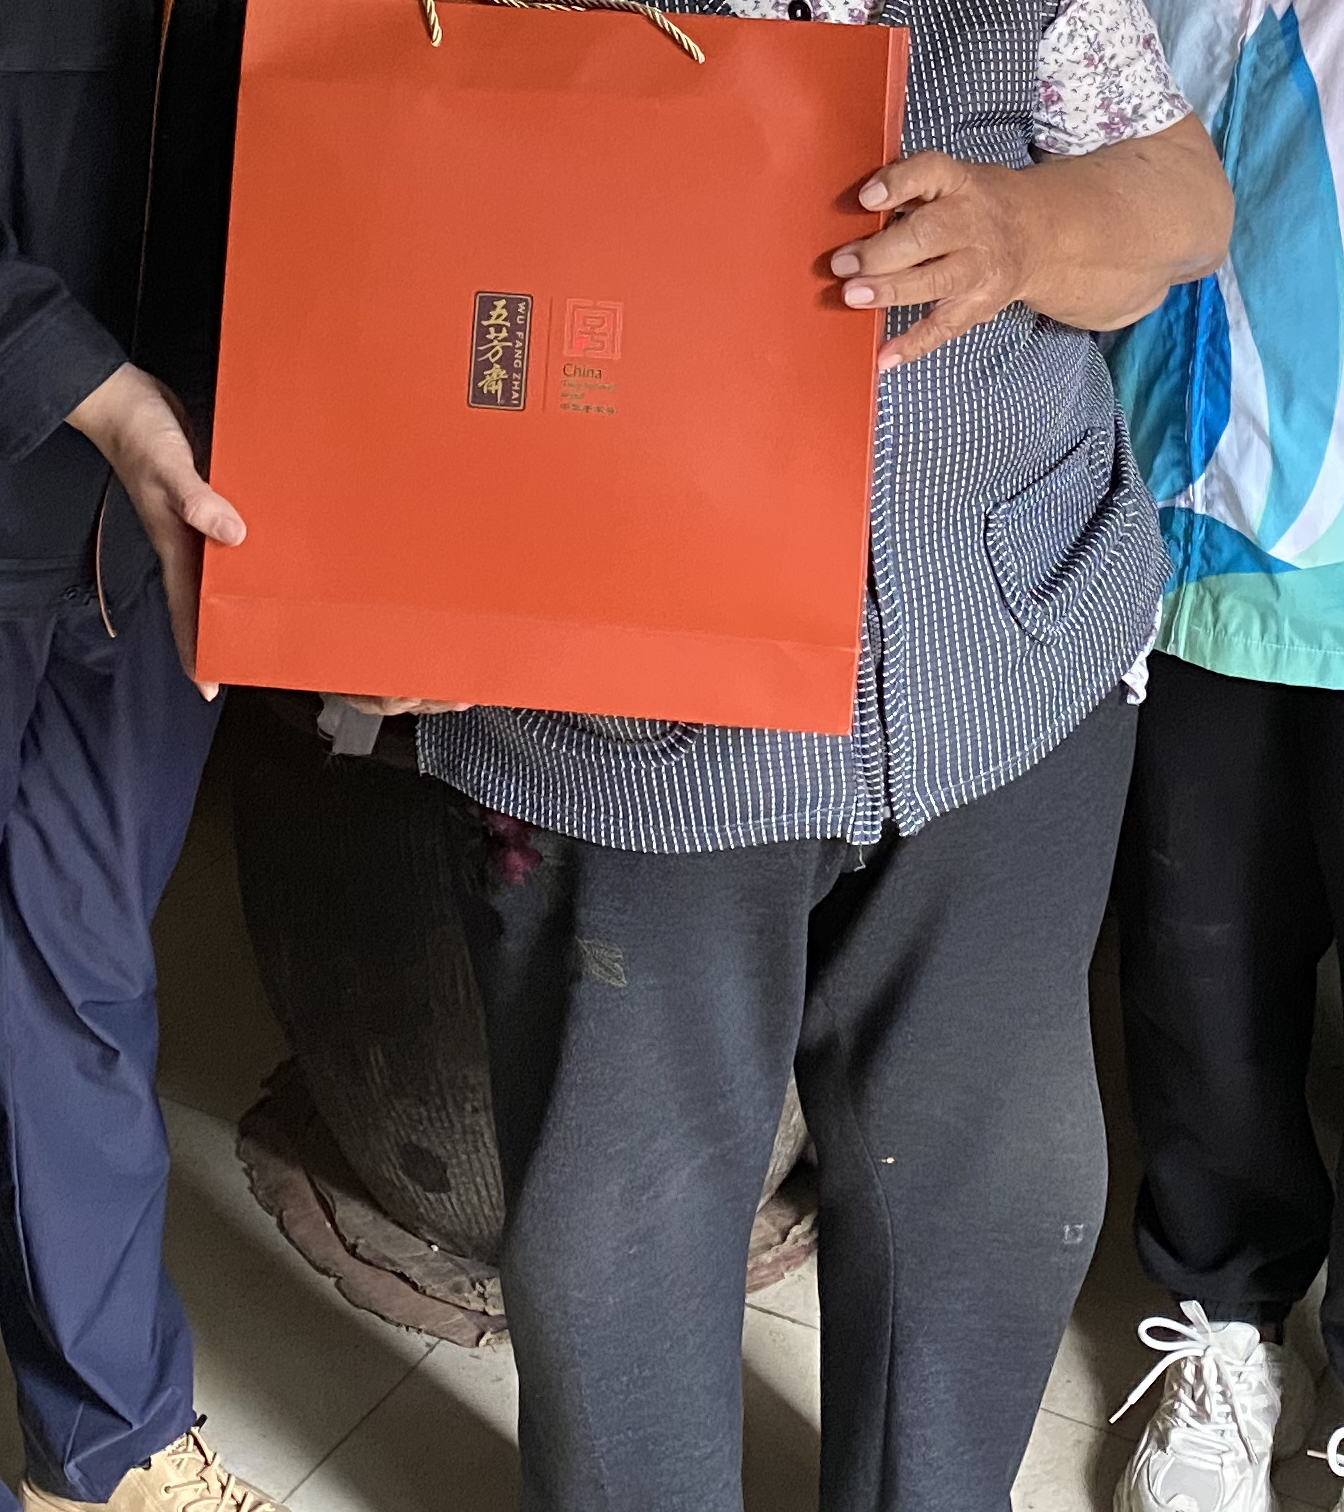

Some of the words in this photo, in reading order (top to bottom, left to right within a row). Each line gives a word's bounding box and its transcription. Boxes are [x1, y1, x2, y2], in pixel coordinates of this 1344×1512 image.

[517, 301, 526, 324] WU
[514, 331, 524, 368] FANG
[562, 363, 602, 380] China
[511, 372, 522, 404] ZHAI
